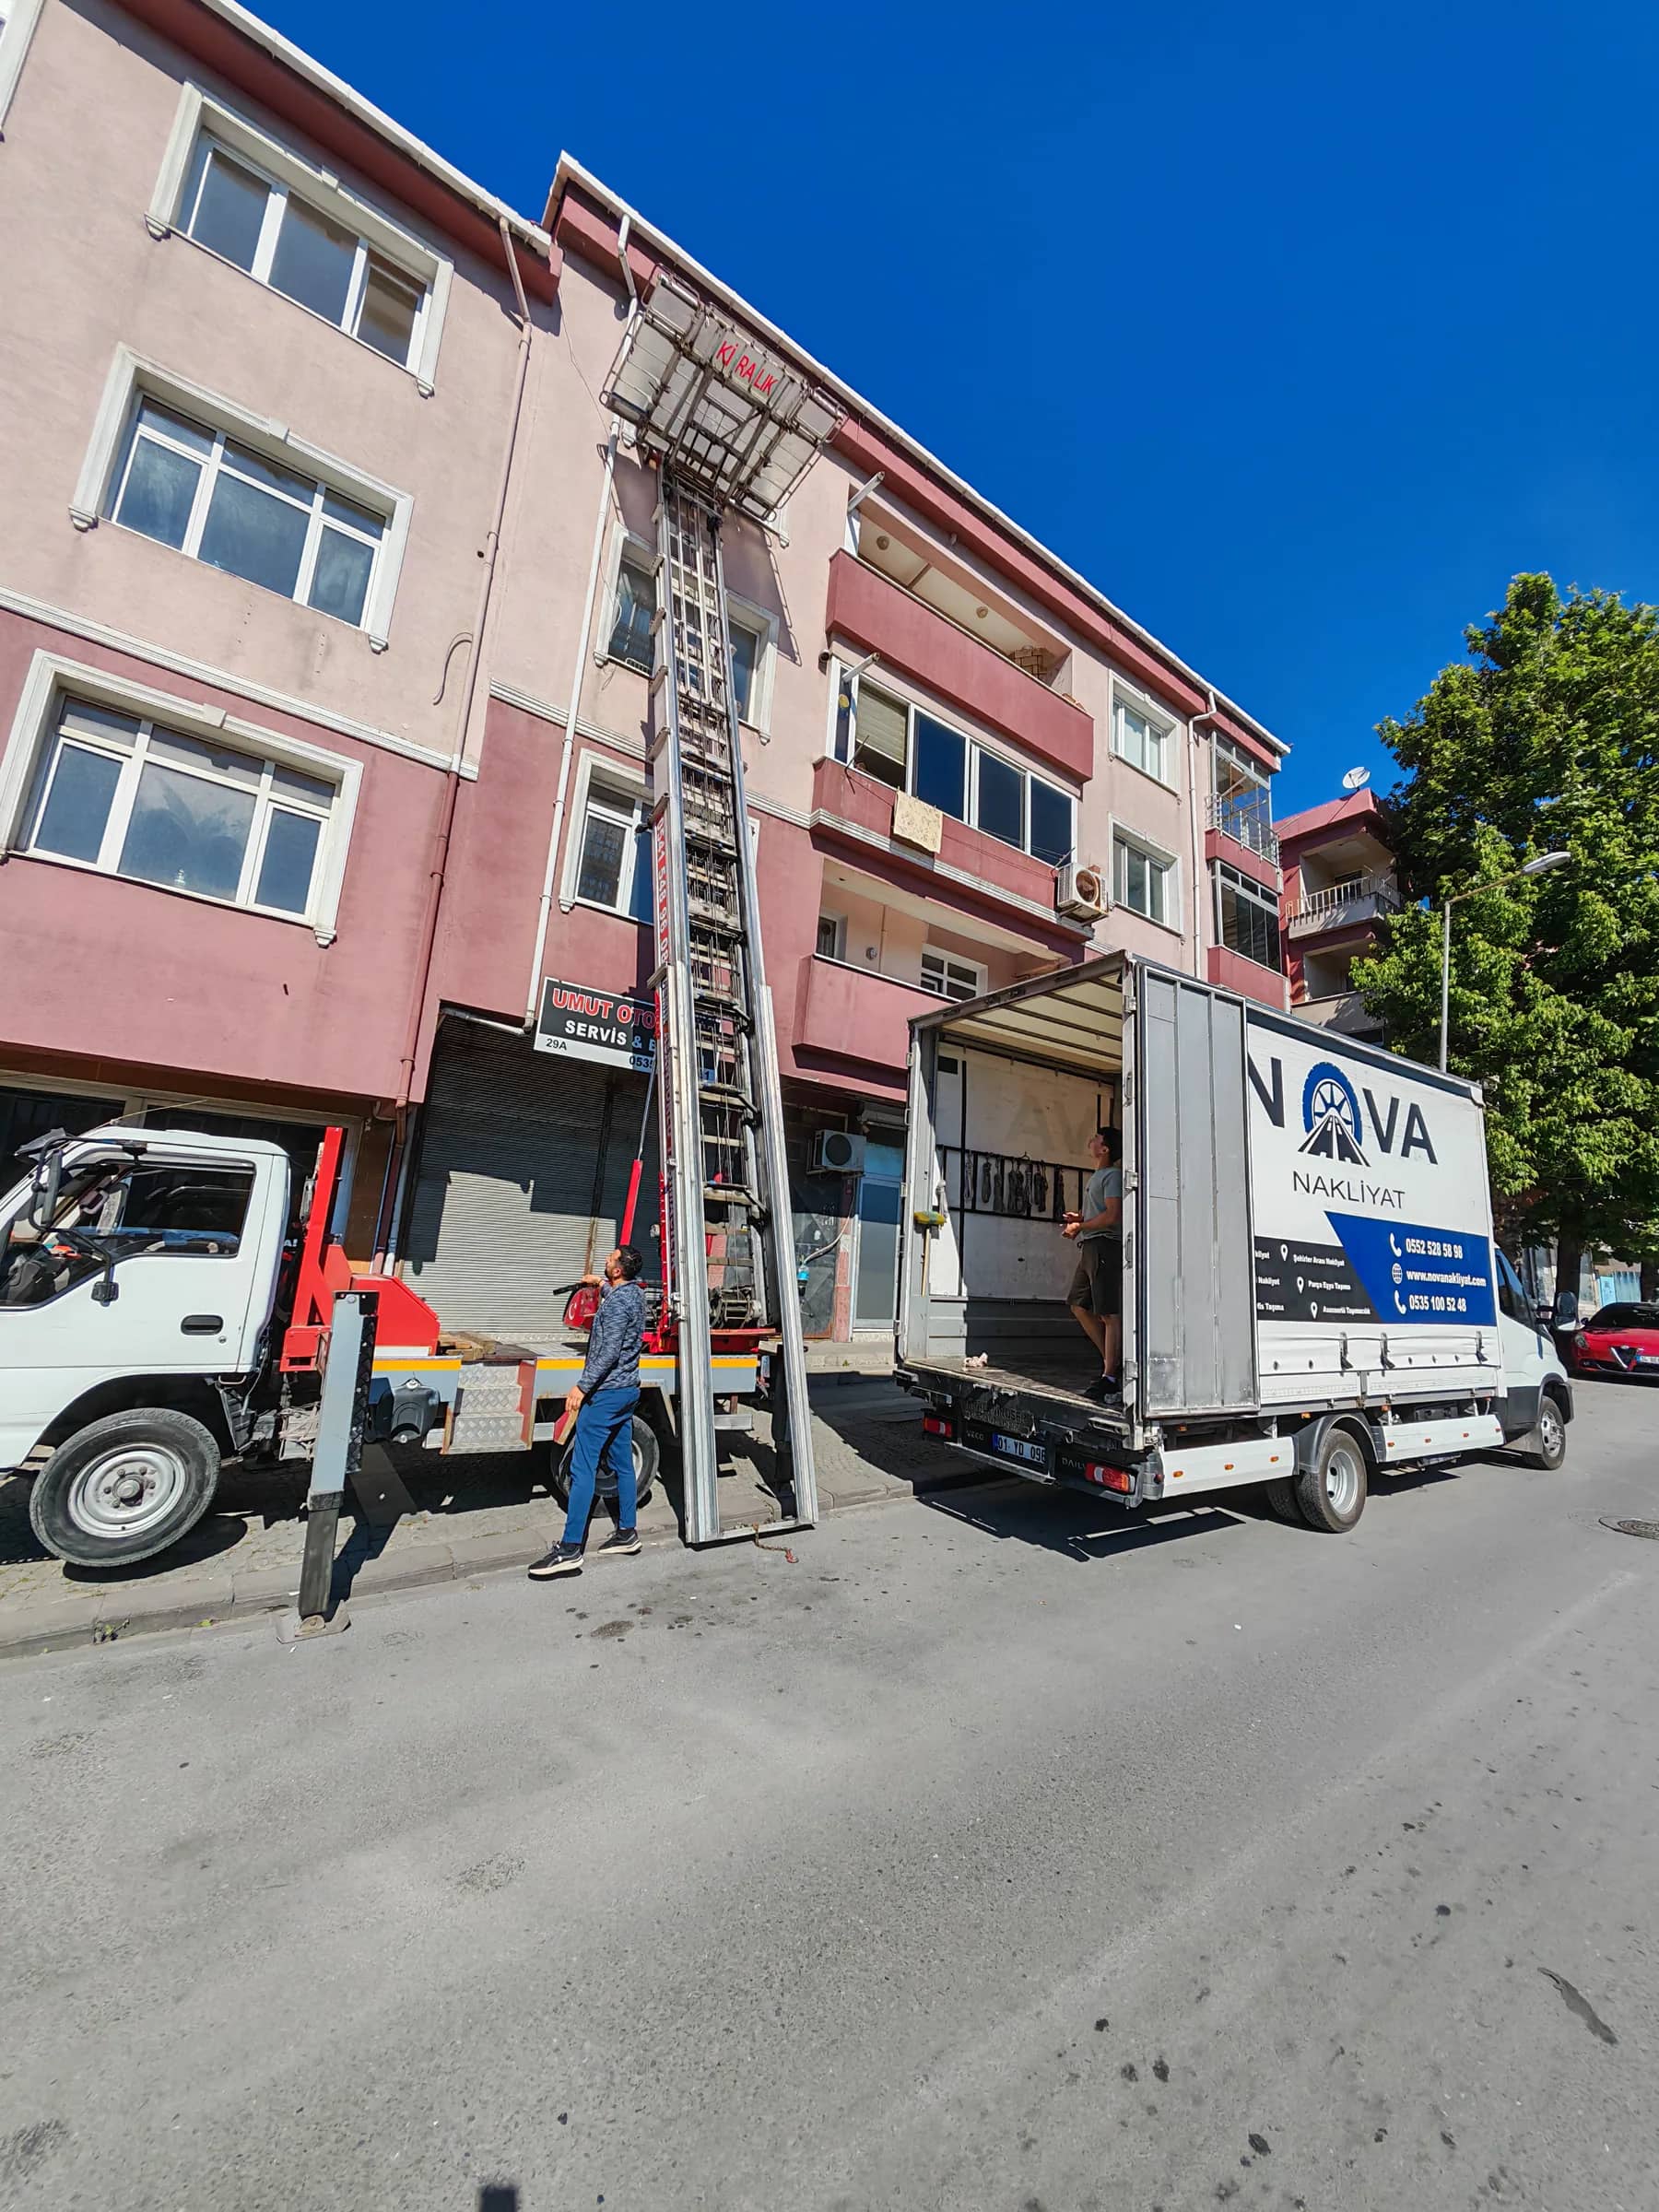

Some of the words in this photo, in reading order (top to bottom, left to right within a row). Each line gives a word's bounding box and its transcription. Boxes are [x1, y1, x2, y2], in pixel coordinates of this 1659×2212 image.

[553, 988, 613, 1019] UMUT
[617, 1004, 655, 1030] OTO
[565, 1019, 627, 1045] SERVİS
[546, 1038, 568, 1051] 29A
[1292, 1171, 1406, 1209] NAKLİYAT
[1406, 1238, 1426, 1254] 0552
[1427, 1240, 1441, 1256] 528
[1442, 1242, 1453, 1258] 58
[1406, 1270, 1487, 1288] www.novanakliyat.com
[1409, 1294, 1430, 1311] 0535
[1430, 1295, 1445, 1312] 100
[1446, 1297, 1456, 1312] 52
[997, 1436, 1007, 1451] 01
[1014, 1441, 1024, 1456] YD
